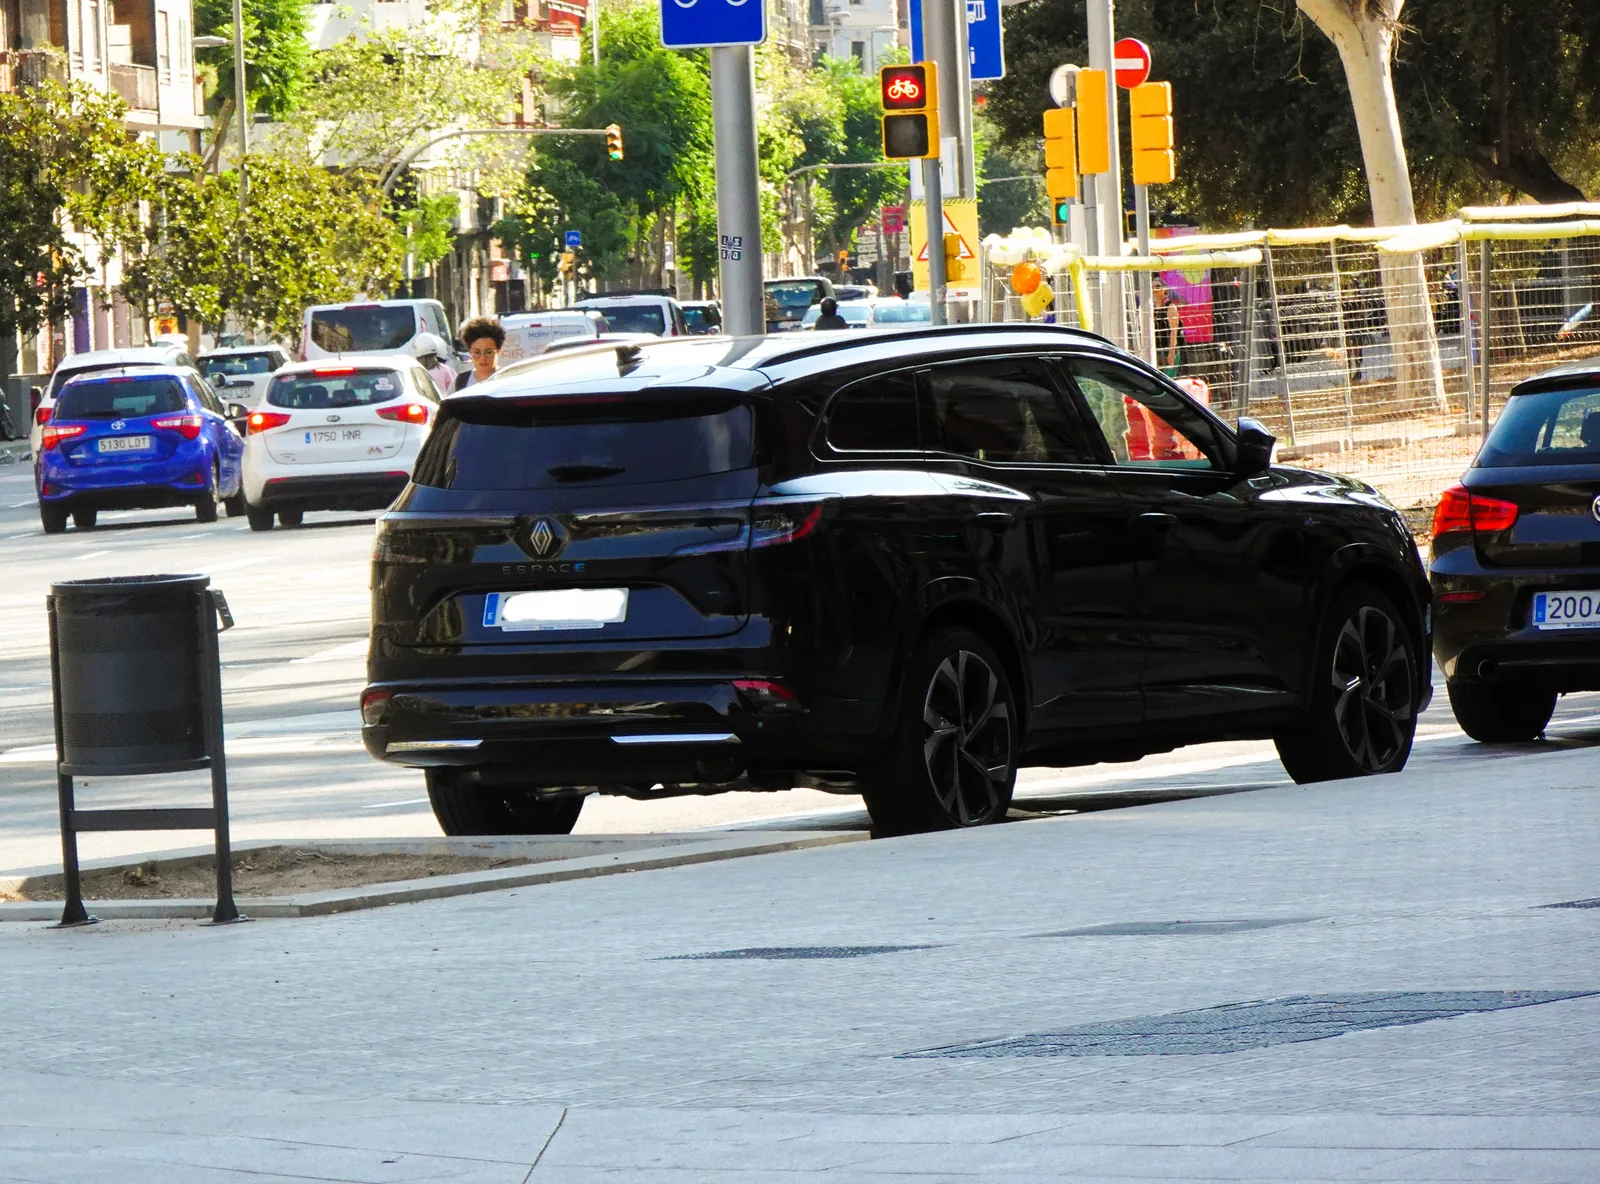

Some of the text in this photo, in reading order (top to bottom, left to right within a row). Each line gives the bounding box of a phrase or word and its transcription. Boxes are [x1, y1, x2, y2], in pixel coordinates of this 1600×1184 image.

[313, 430, 361, 442] 1750 HNR
[100, 437, 147, 450] 5130 LDT
[502, 563, 585, 575] ESPACE
